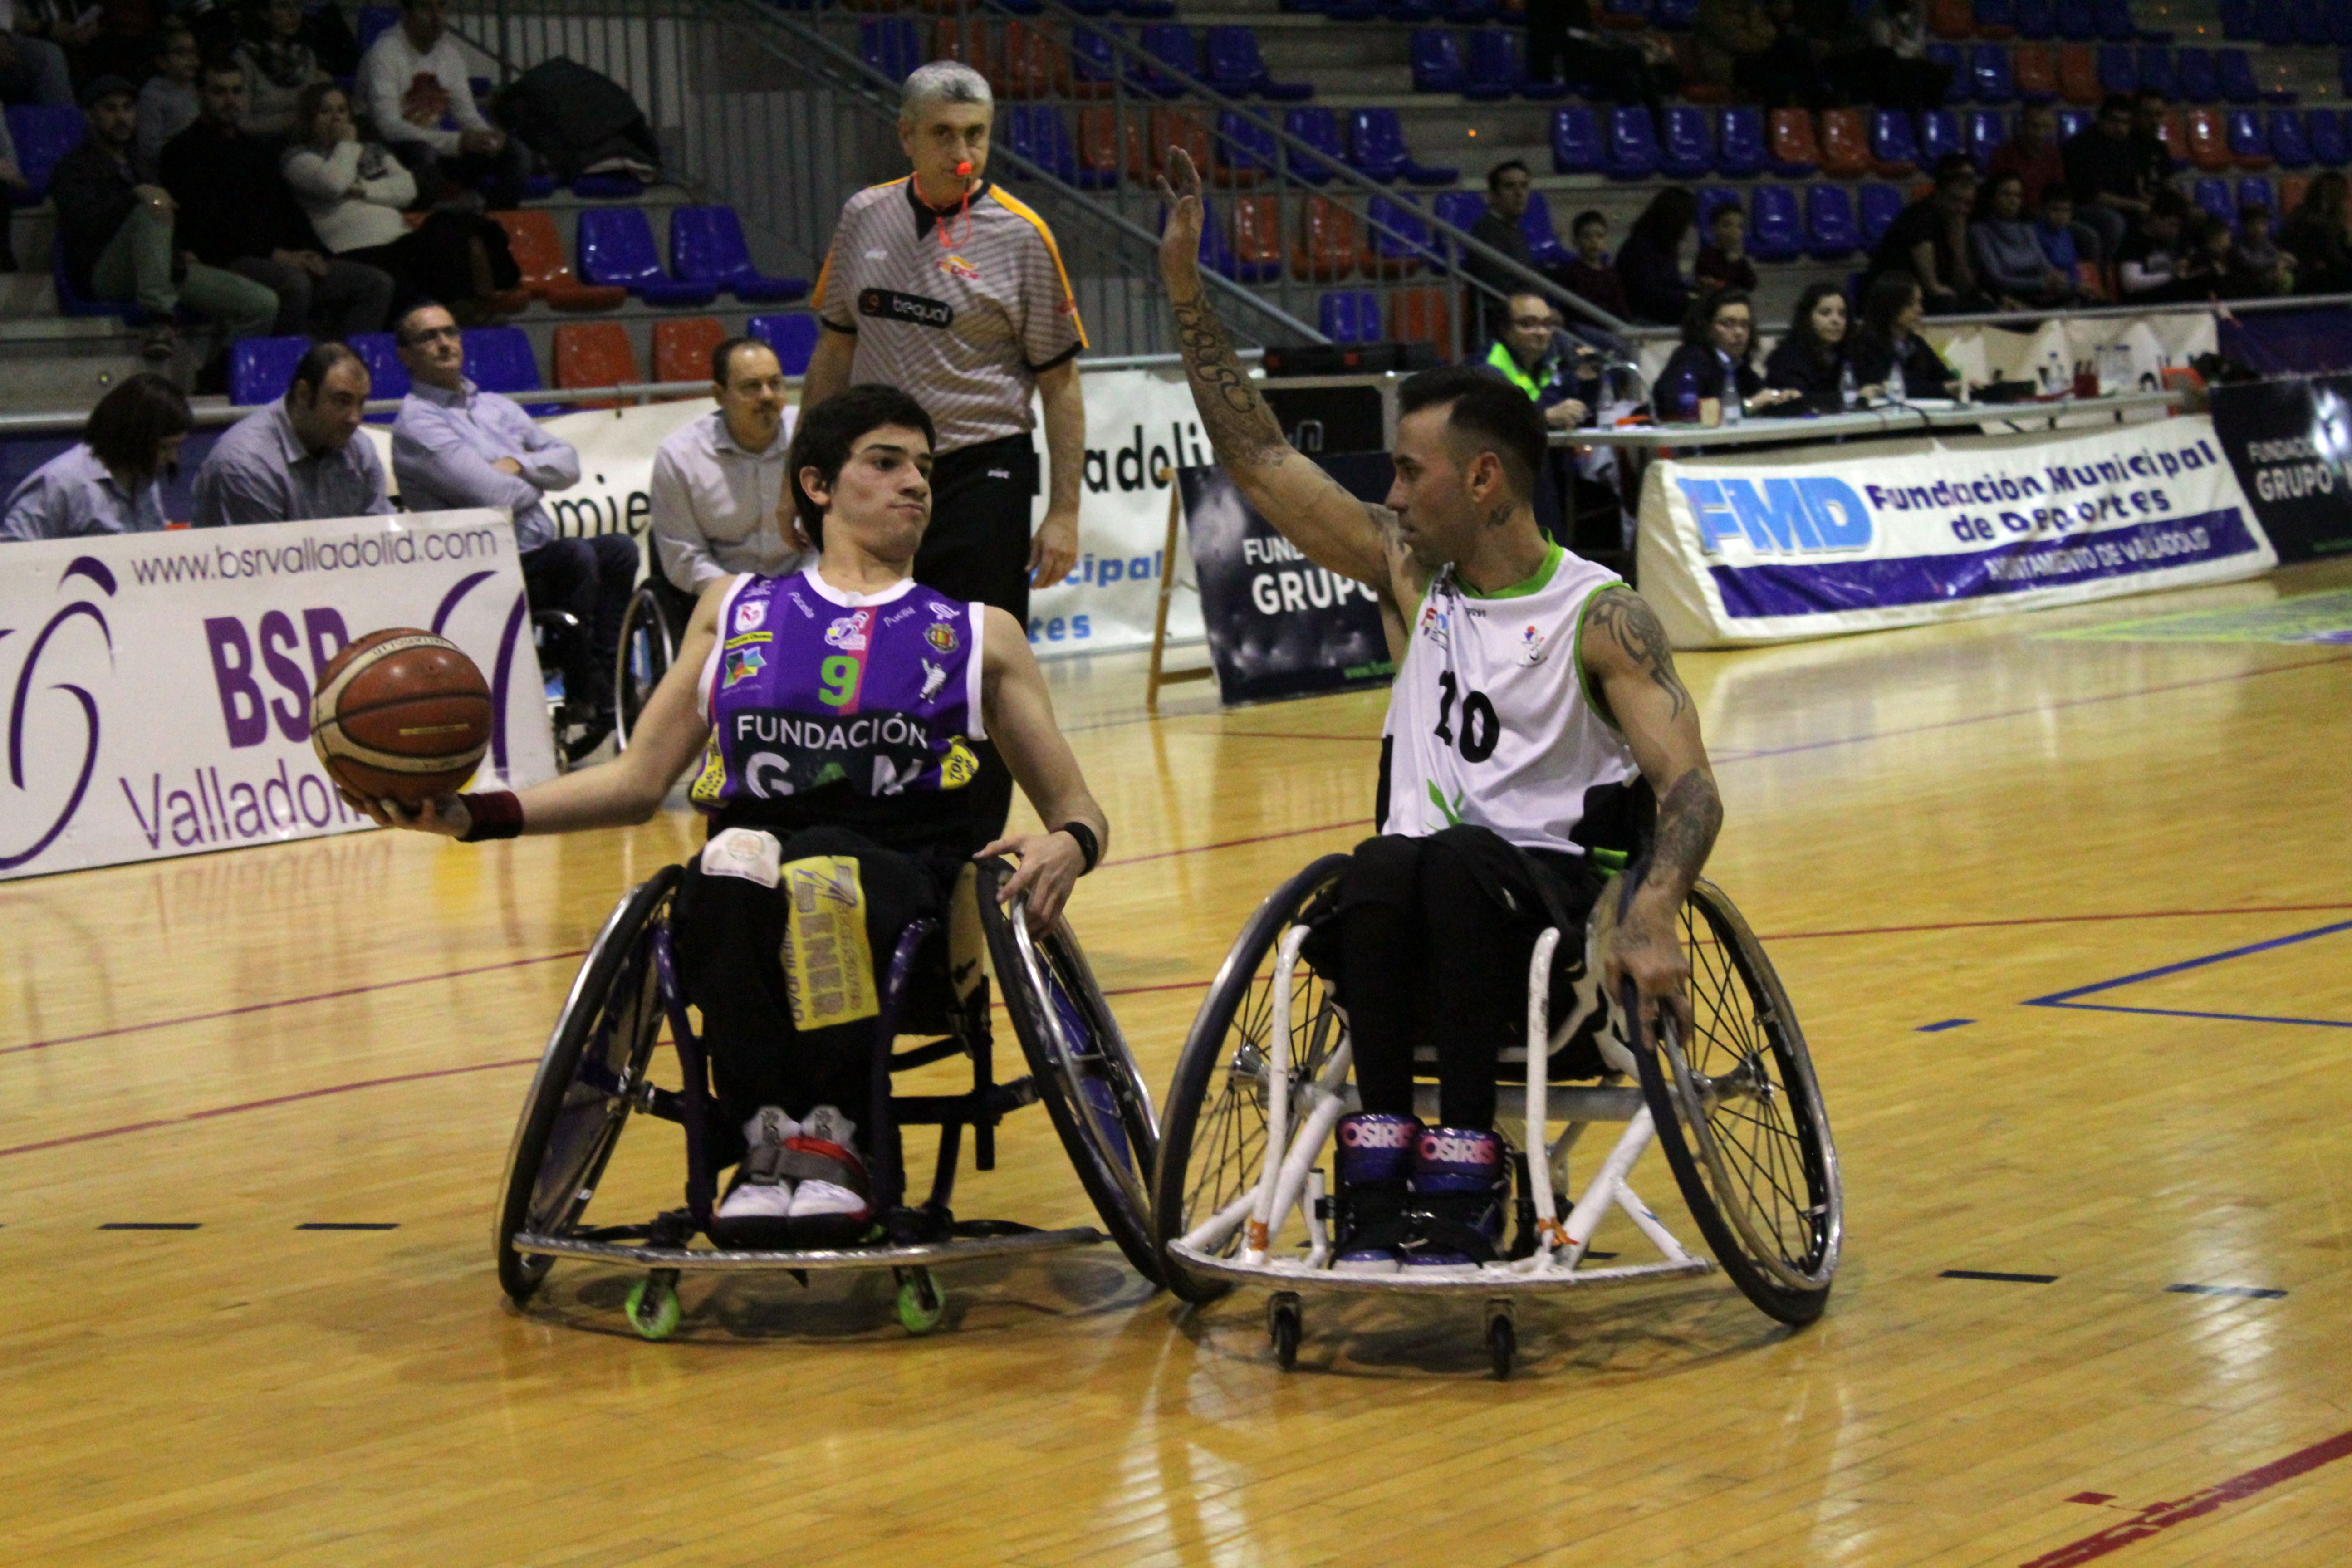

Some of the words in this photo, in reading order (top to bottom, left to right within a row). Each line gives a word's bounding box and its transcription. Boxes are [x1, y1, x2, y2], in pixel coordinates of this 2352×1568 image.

[1083, 422, 1208, 494] adoli
[1863, 470, 2043, 511] Fundación
[2044, 438, 2218, 495] Municipal
[2256, 463, 2333, 502] GRUPO
[551, 473, 650, 538] mie
[1676, 477, 1873, 554] FMD
[1951, 513, 1995, 542] de
[131, 526, 498, 585] www.bsrvalladolid.com
[2094, 542, 2125, 566] DE
[1027, 615, 1091, 643] tes
[818, 655, 859, 707] 9
[737, 712, 928, 750] FUNDACIÓN
[118, 758, 362, 850] Valladol
[1419, 1136, 1495, 1165] OSIRIS
